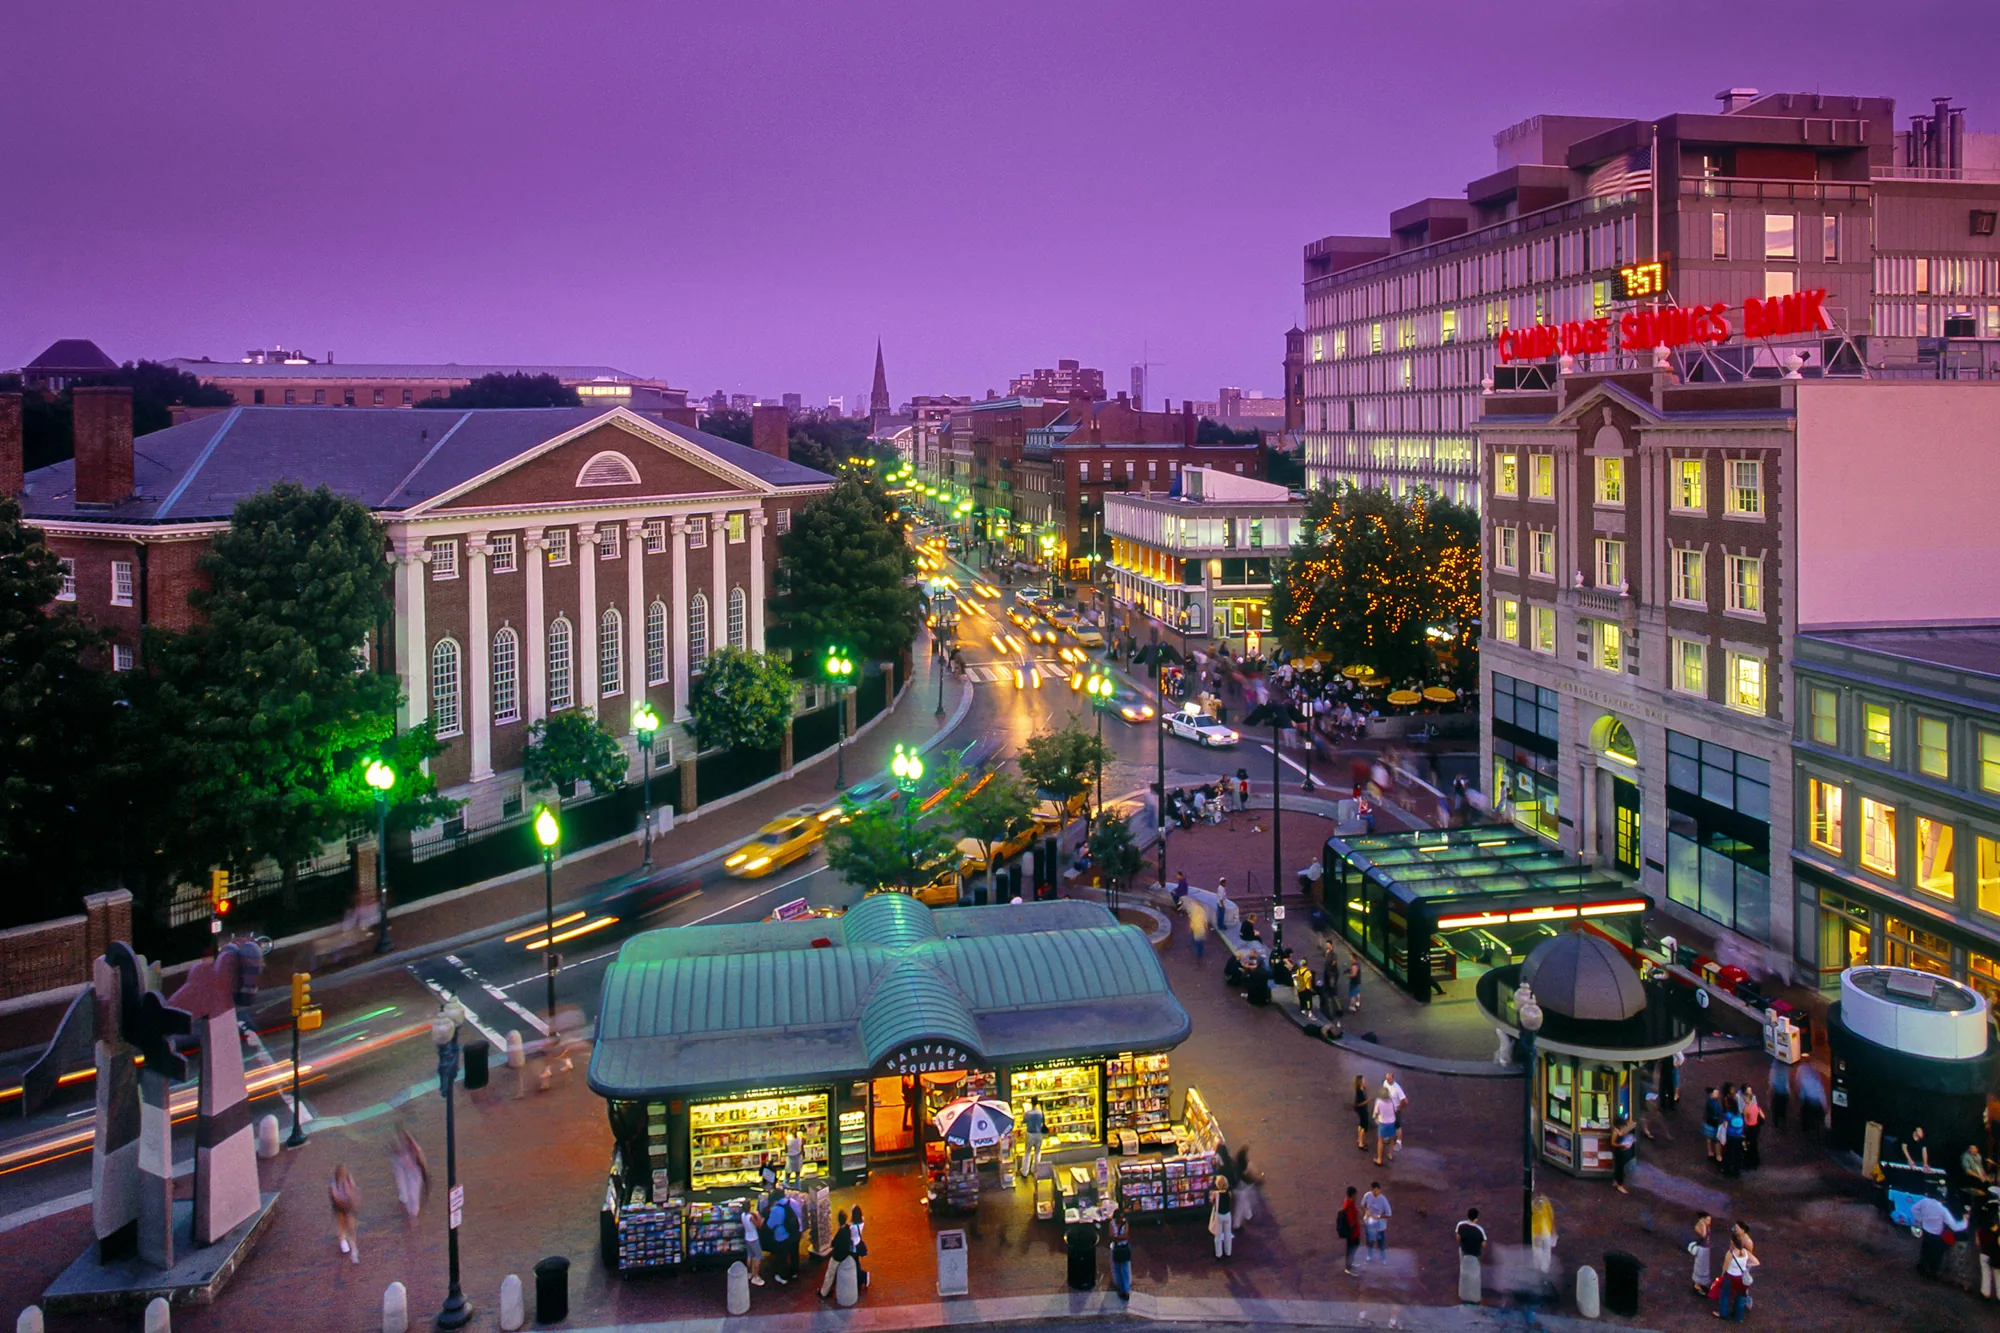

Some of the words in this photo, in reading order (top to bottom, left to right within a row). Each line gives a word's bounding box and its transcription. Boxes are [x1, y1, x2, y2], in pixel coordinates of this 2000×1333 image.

[1620, 262, 1662, 297] 7:57
[1498, 317, 1609, 363] CAMBRIDGE
[1619, 302, 1731, 351] SAVINGS
[1743, 288, 1832, 339] BANK
[1602, 694, 1642, 714] SAVINGS
[886, 1044, 967, 1070] HARVARD
[899, 1059, 955, 1074] SQUARE
